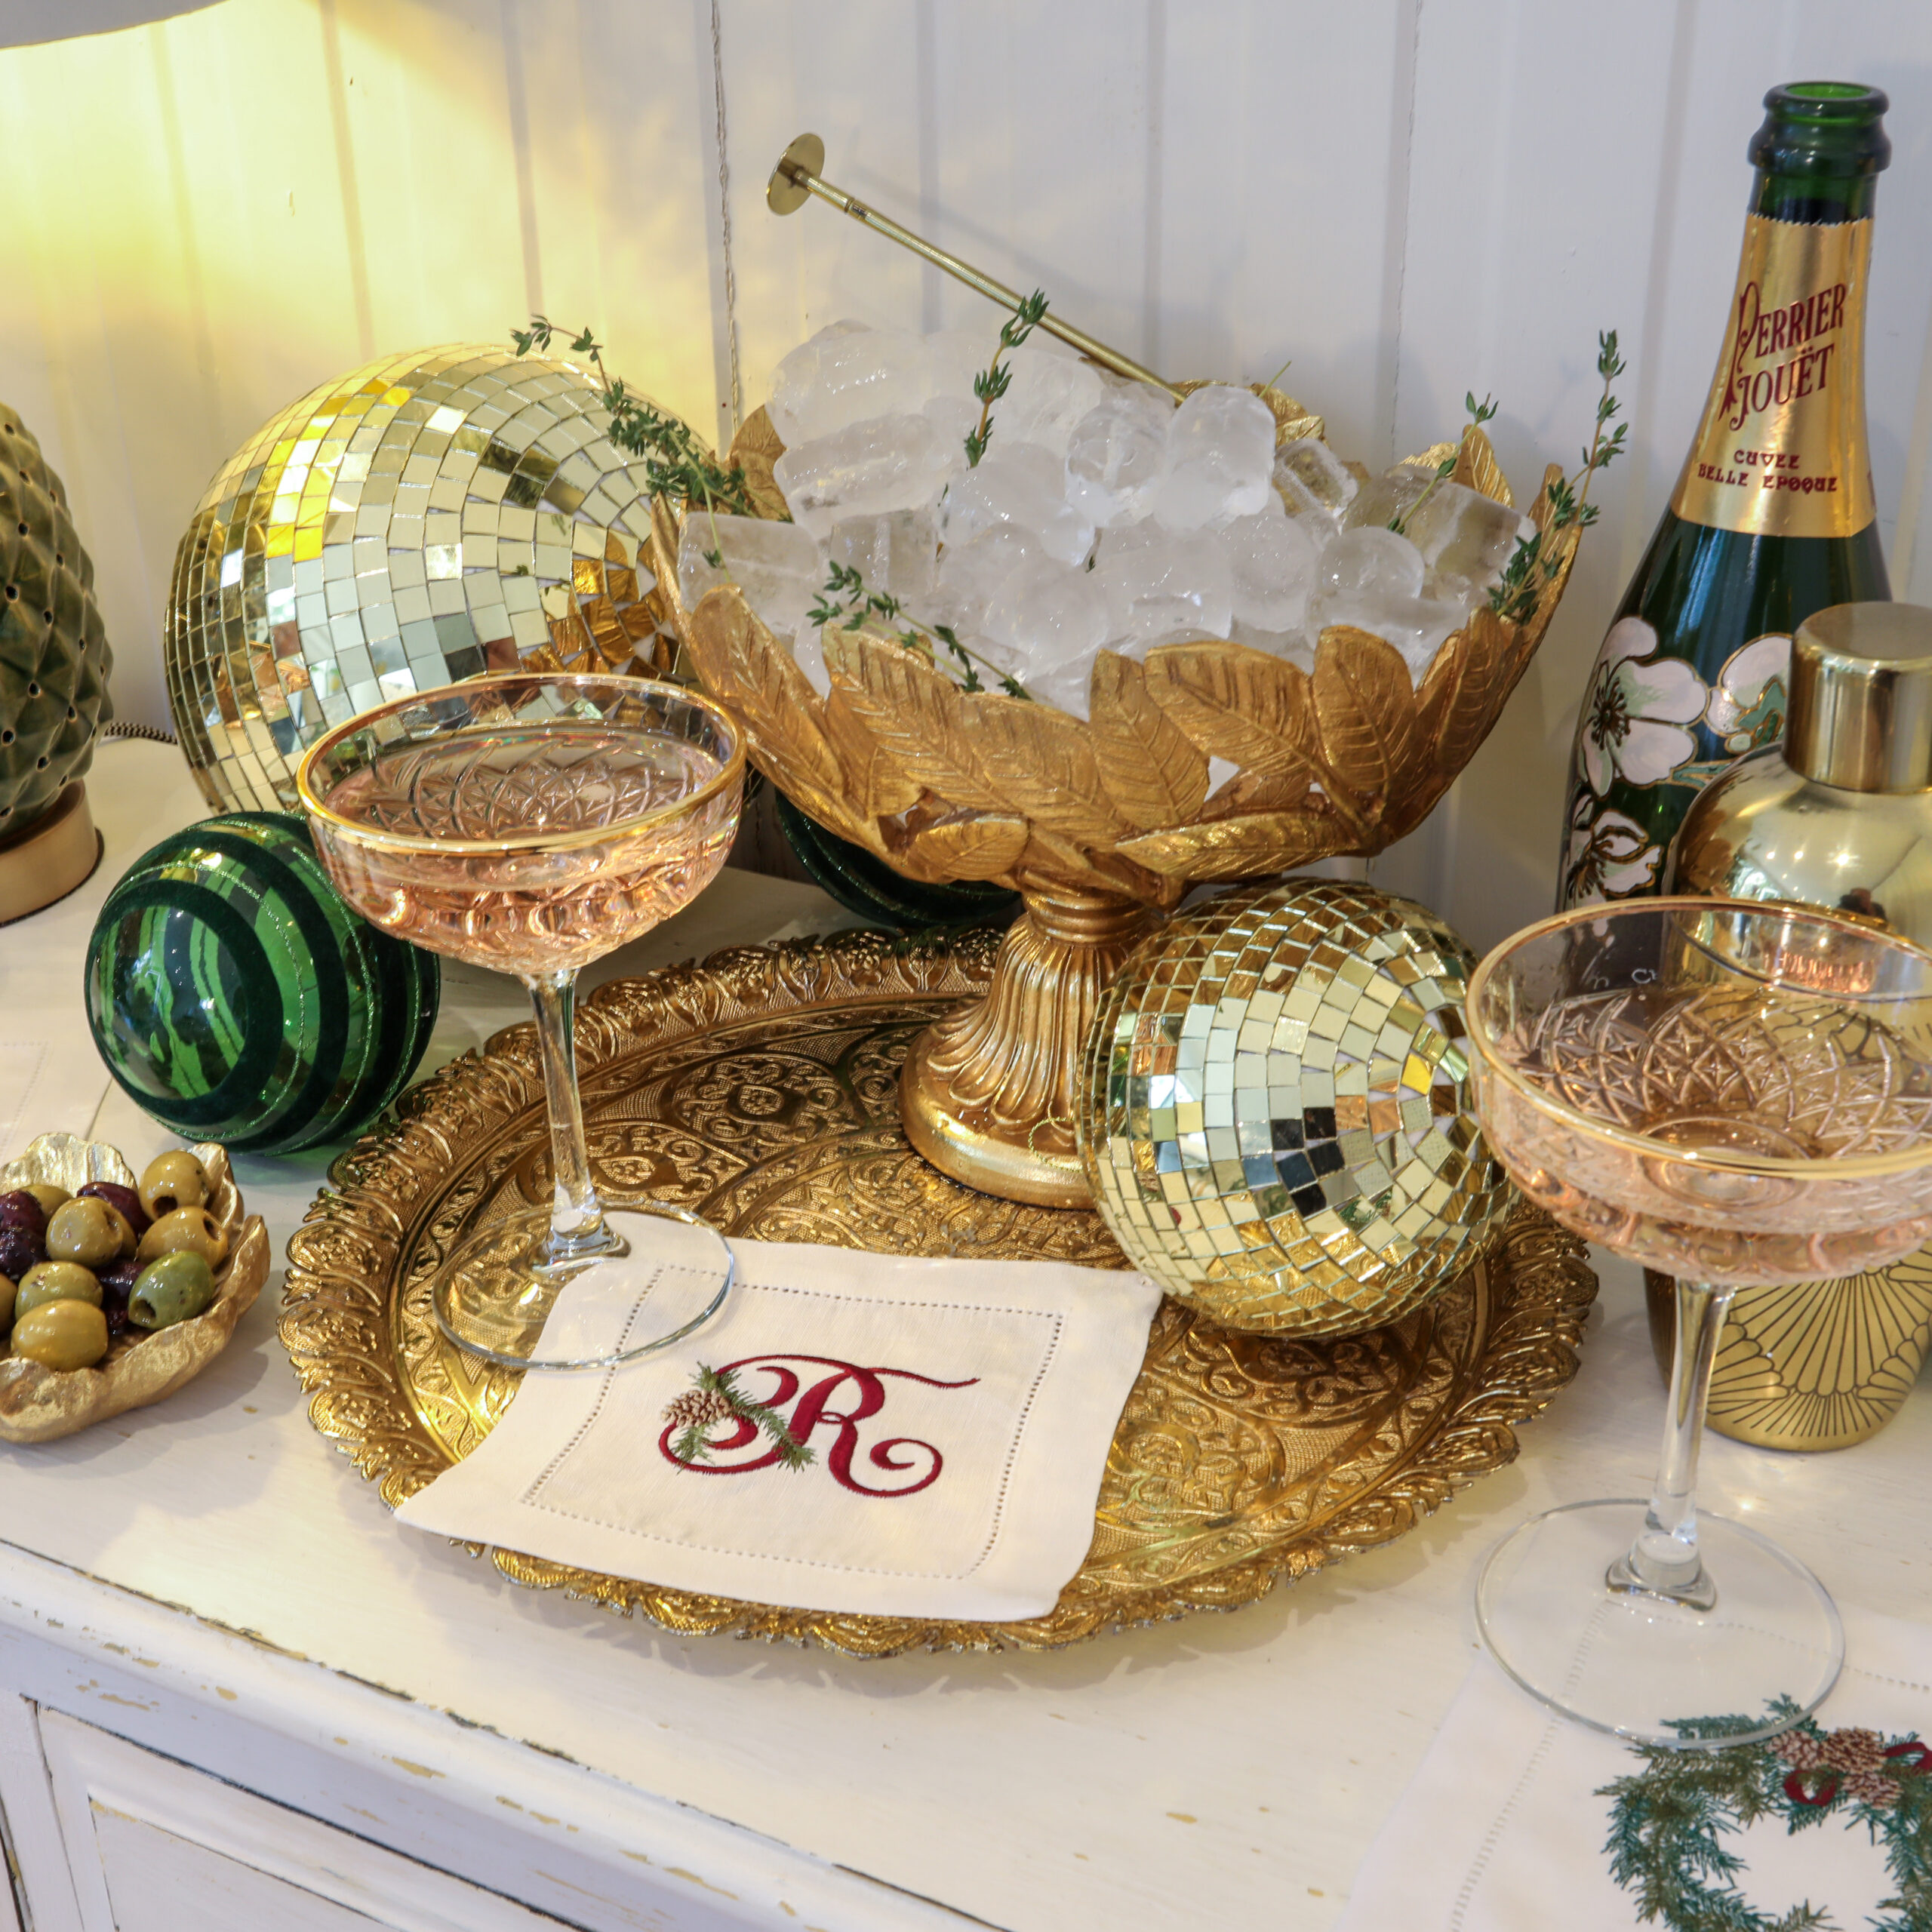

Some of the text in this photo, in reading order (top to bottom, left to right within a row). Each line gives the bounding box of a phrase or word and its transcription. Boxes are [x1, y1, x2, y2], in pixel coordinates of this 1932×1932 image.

[1718, 281, 1847, 421] PERRIER
[1729, 343, 1835, 431] JOUËT
[1698, 463, 1838, 495] BELLE EPOQUE
[658, 1354, 981, 1498] R
